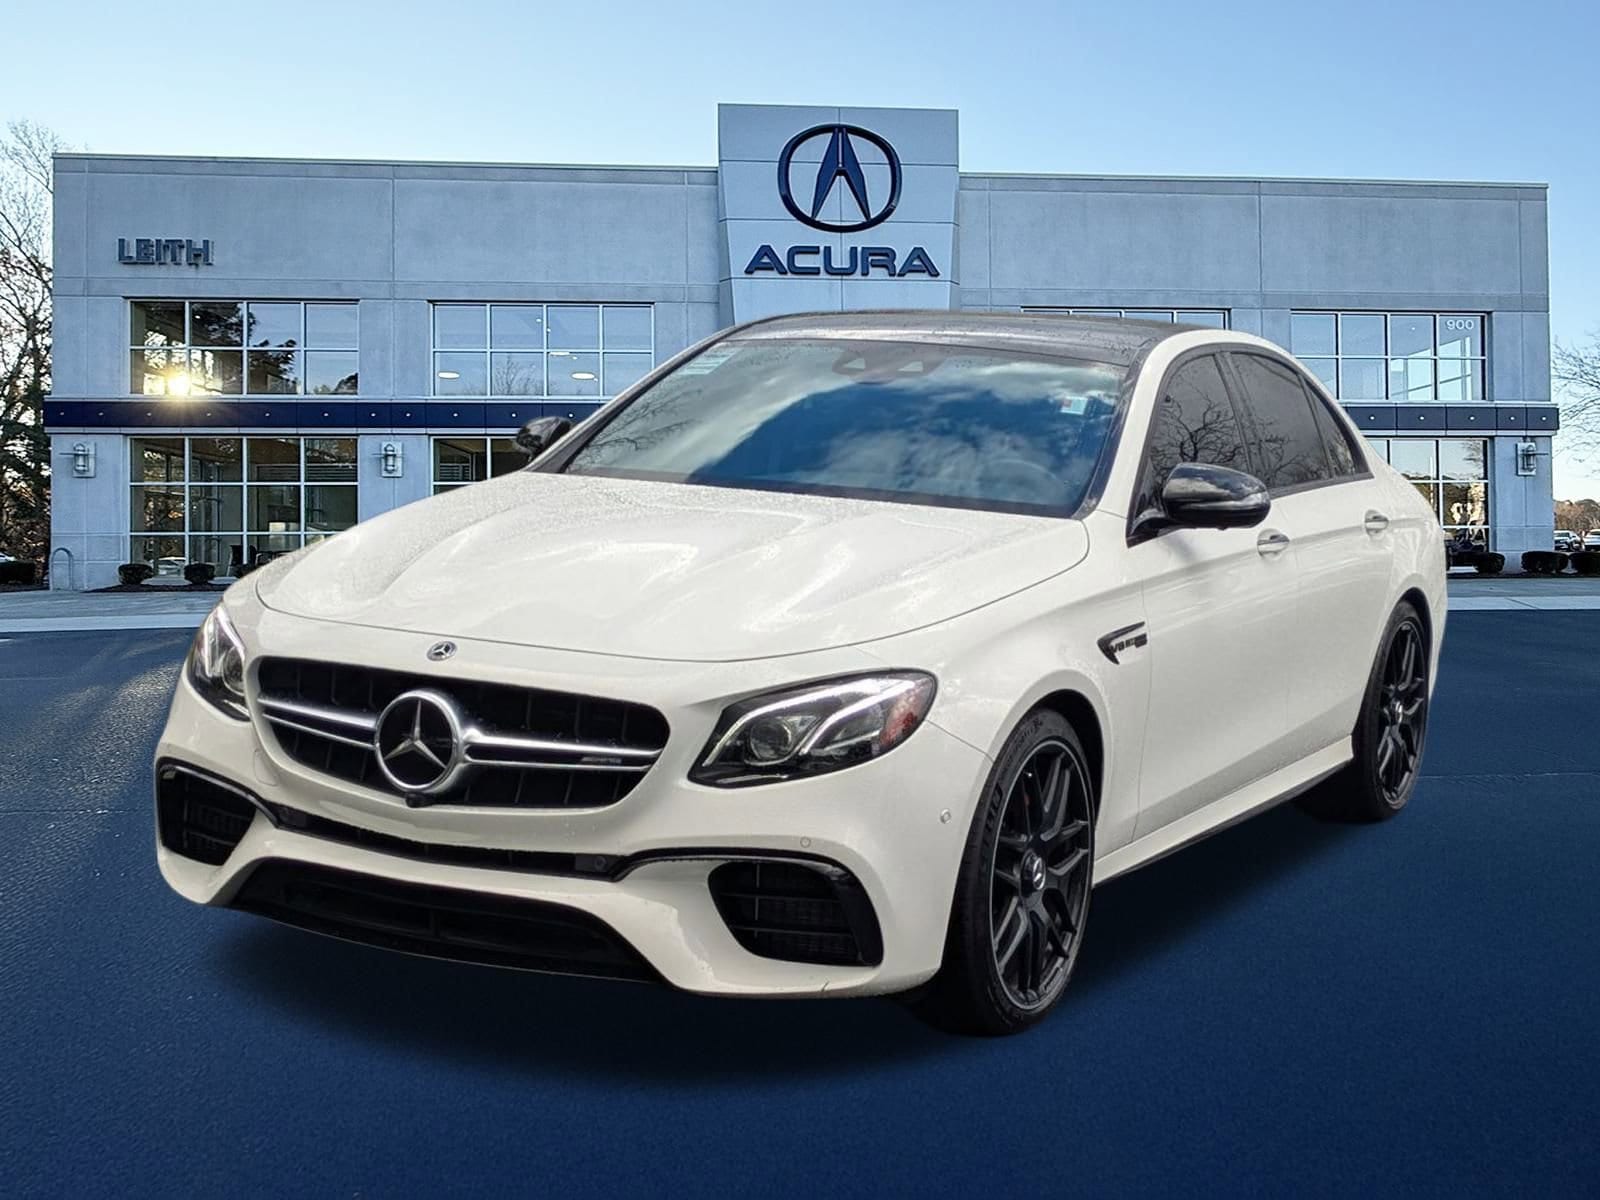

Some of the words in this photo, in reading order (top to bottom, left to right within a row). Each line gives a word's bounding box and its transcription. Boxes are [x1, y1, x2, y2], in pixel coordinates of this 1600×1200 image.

[118, 238, 212, 264] LEITH
[744, 245, 940, 277] ACURA
[1446, 319, 1474, 330] 900
